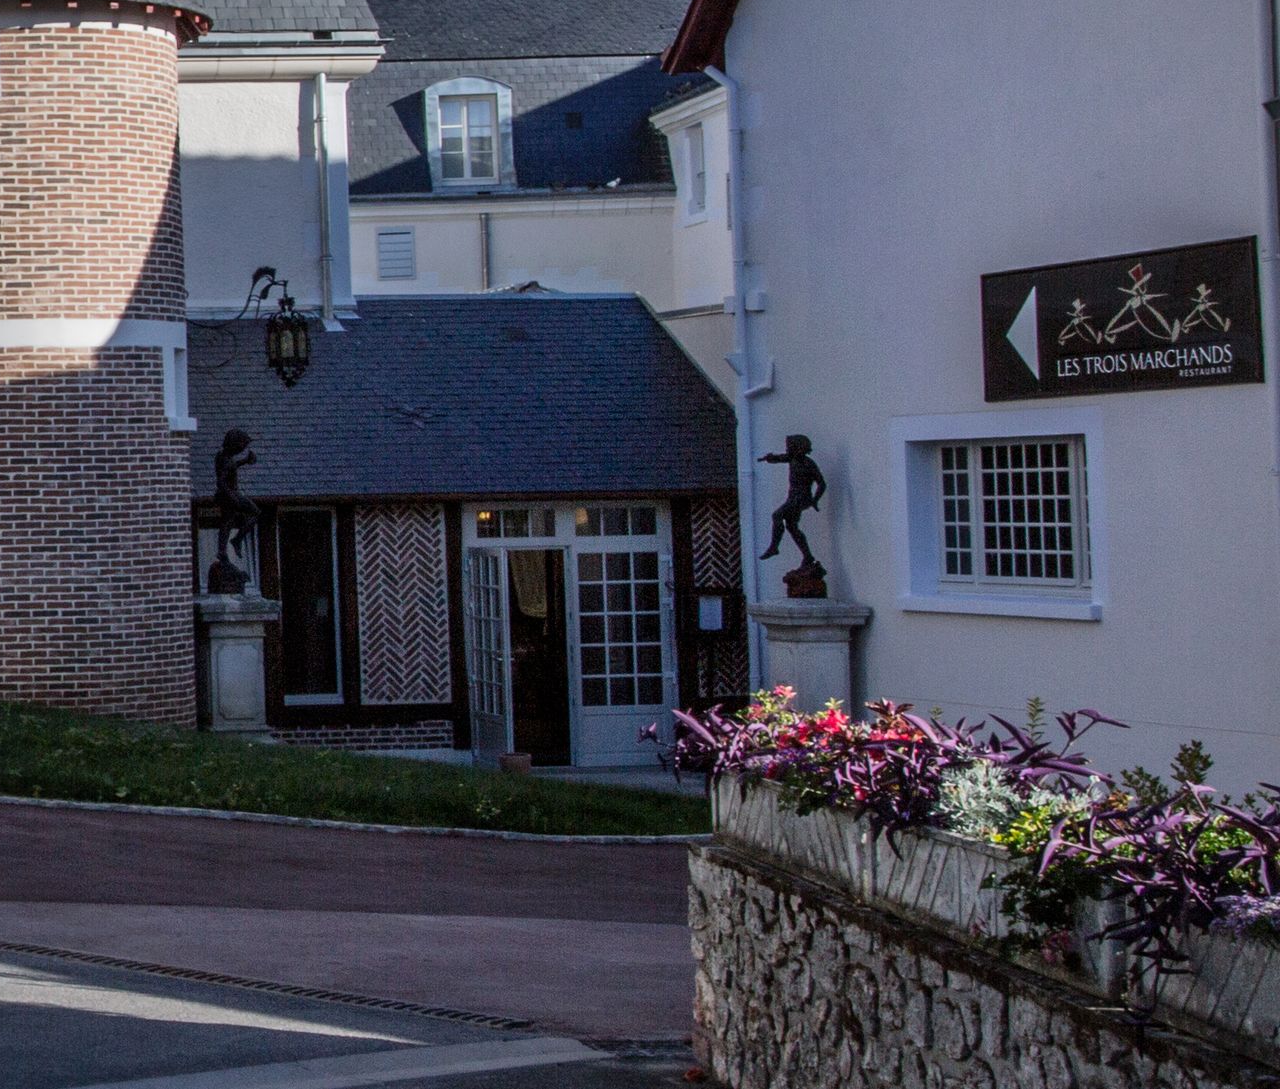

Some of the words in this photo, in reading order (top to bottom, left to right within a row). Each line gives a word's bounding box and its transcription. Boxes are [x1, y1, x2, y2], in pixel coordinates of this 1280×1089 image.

[1057, 358, 1080, 377] LES
[1083, 353, 1127, 375] TROIS
[1130, 343, 1233, 371] MARCHANDS
[1179, 365, 1232, 377] RESTAURANT
